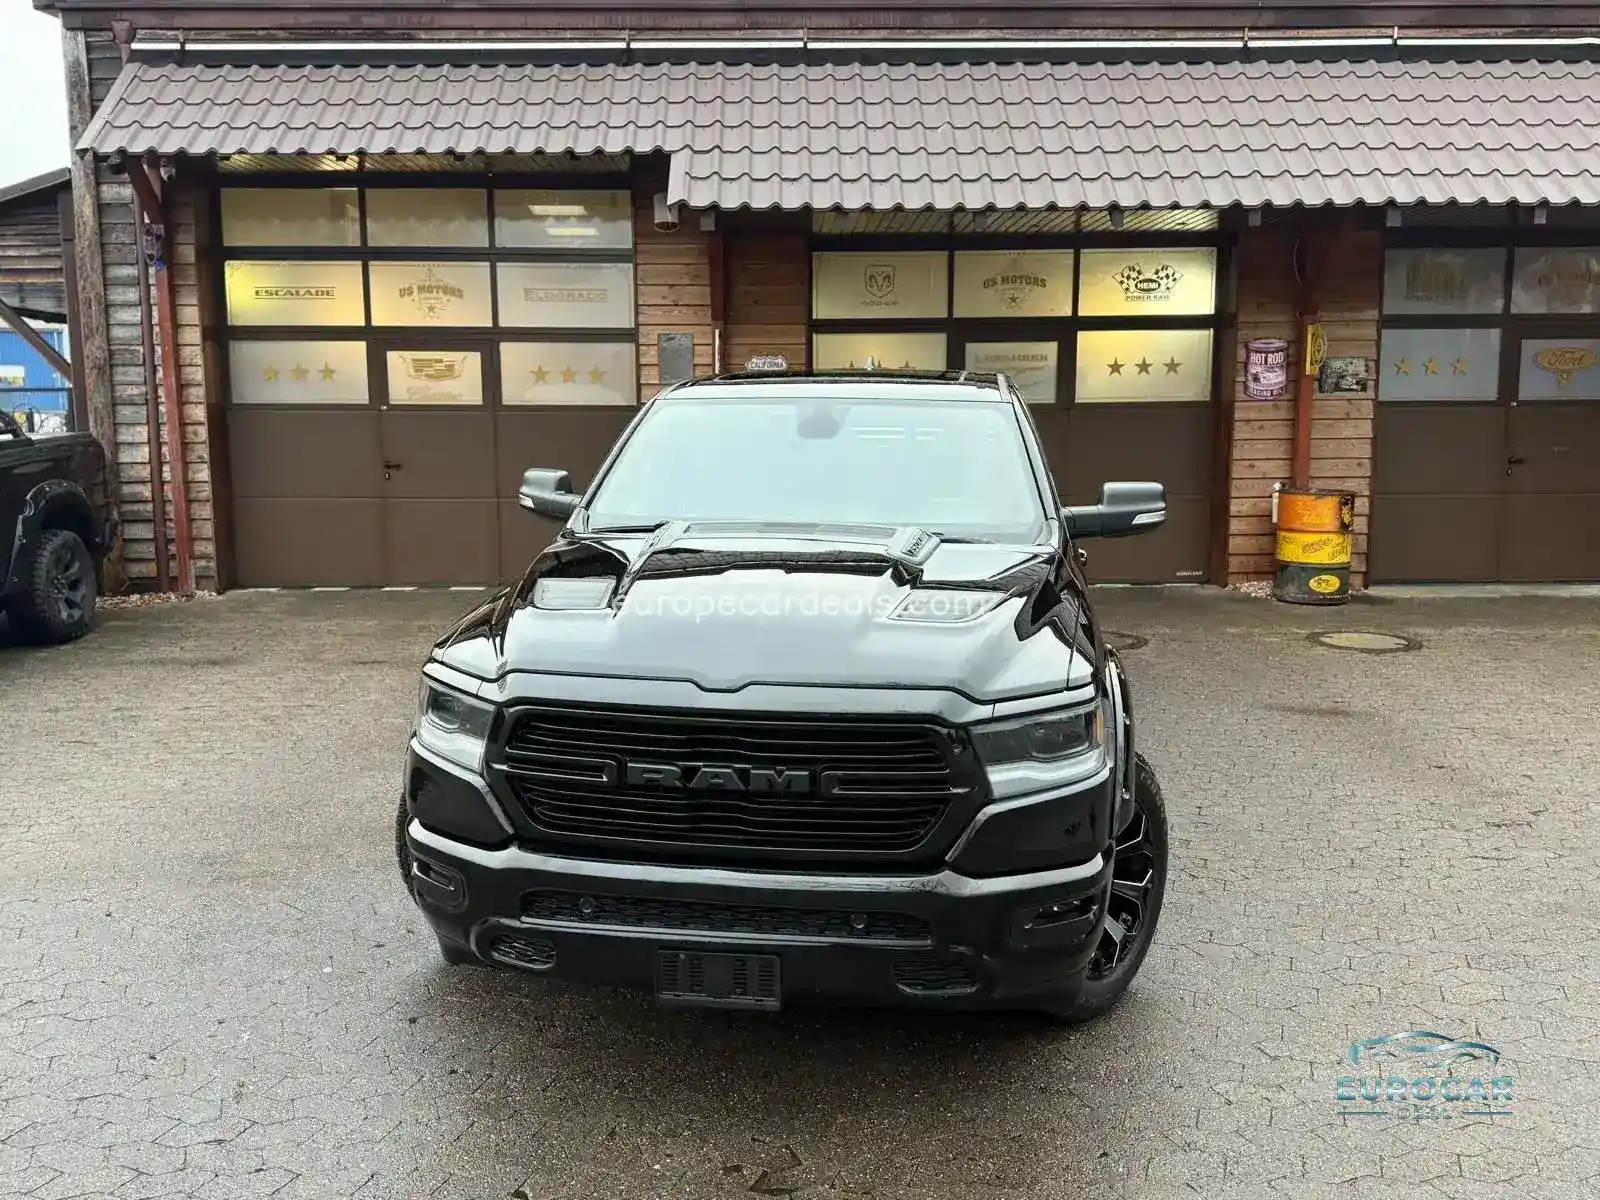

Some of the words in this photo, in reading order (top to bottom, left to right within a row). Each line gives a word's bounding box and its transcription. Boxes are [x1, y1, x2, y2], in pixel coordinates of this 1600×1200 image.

[983, 277, 998, 289] US
[1000, 275, 1047, 288] MOTORS
[1137, 281, 1159, 290] HEMI
[254, 289, 335, 297] ESCALADE
[398, 285, 413, 298] US
[417, 284, 463, 300] MOTORS
[750, 361, 784, 369] CALIFORNIA
[1250, 352, 1267, 364] HOT
[1267, 352, 1284, 365] ROD
[627, 762, 810, 792] RAM
